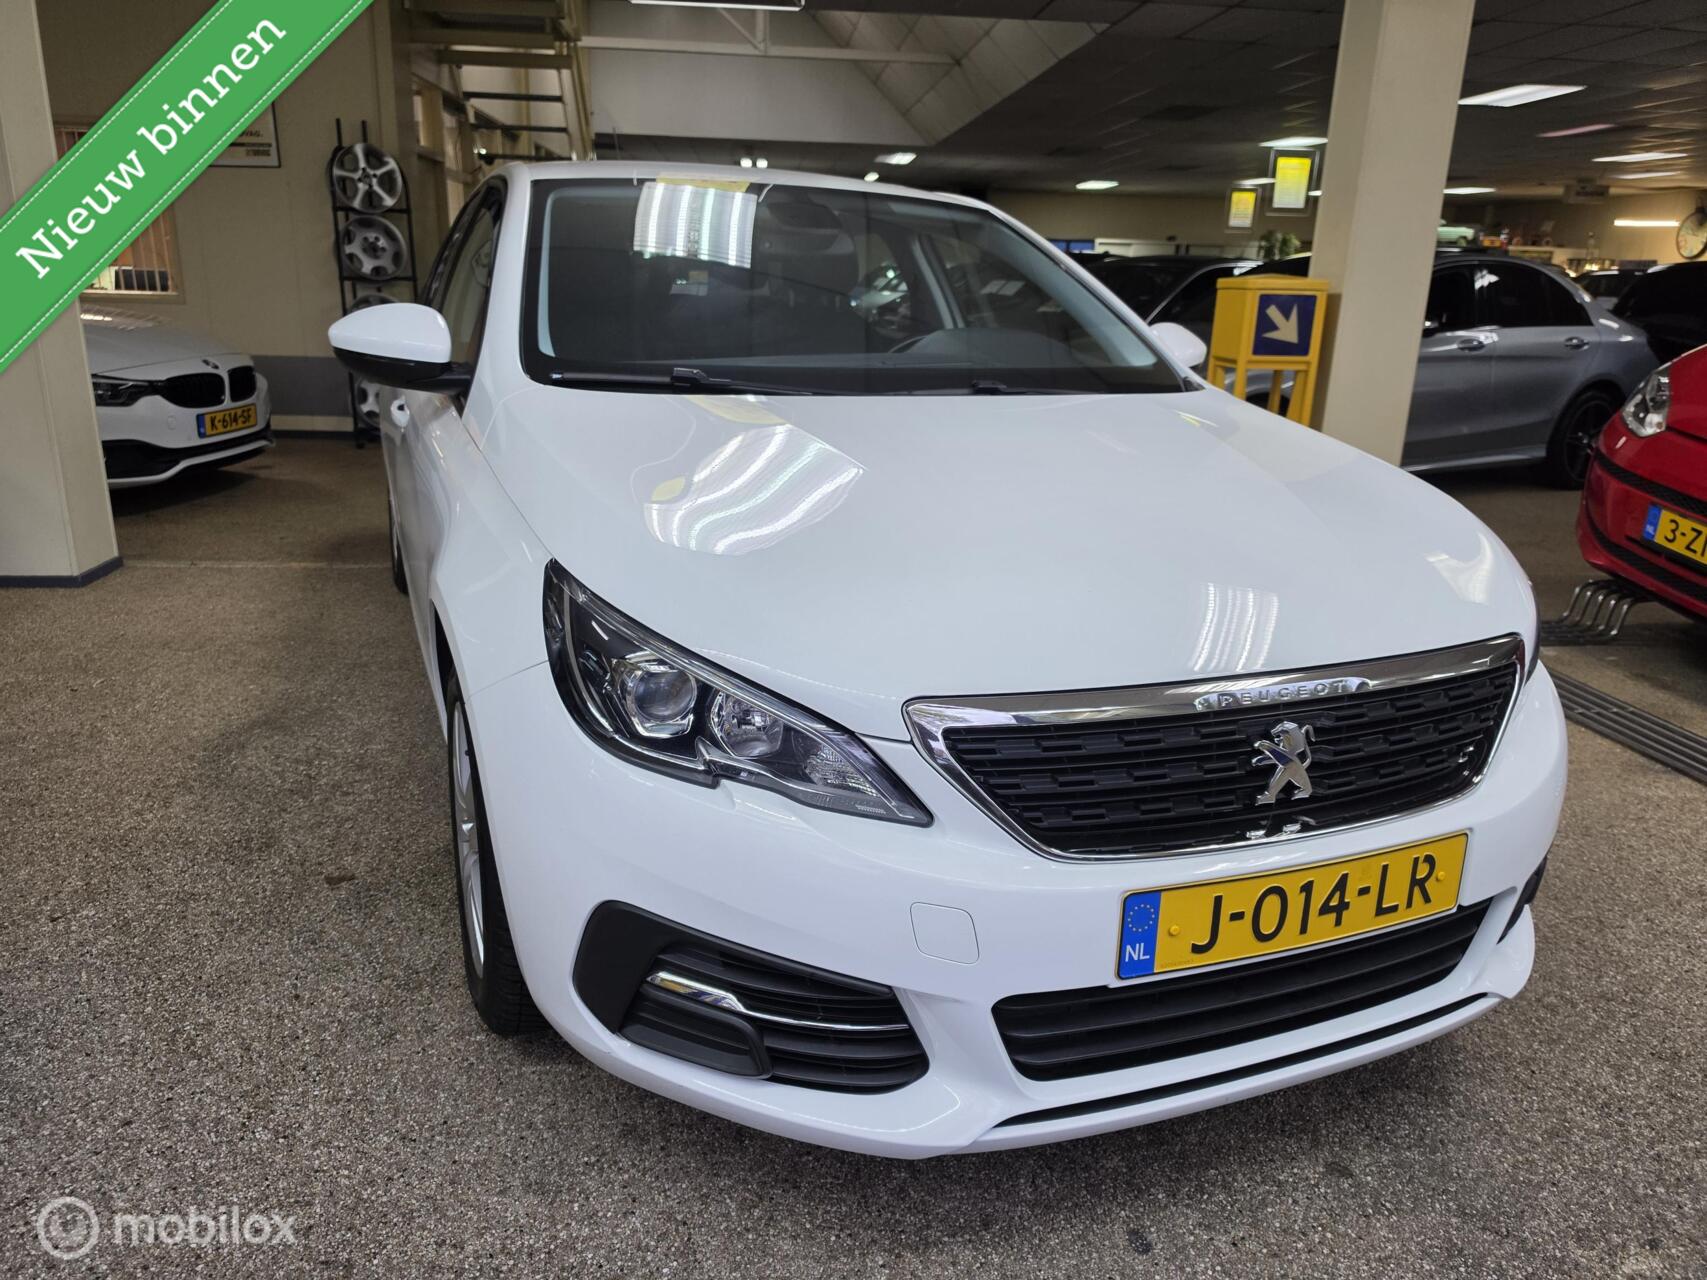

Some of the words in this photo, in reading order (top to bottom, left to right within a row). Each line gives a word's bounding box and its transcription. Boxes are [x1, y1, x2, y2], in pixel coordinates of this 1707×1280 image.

[1218, 679, 1347, 707] PEUGEOT
[1190, 852, 1437, 955] J-014-LR
[1124, 942, 1151, 962] NL
